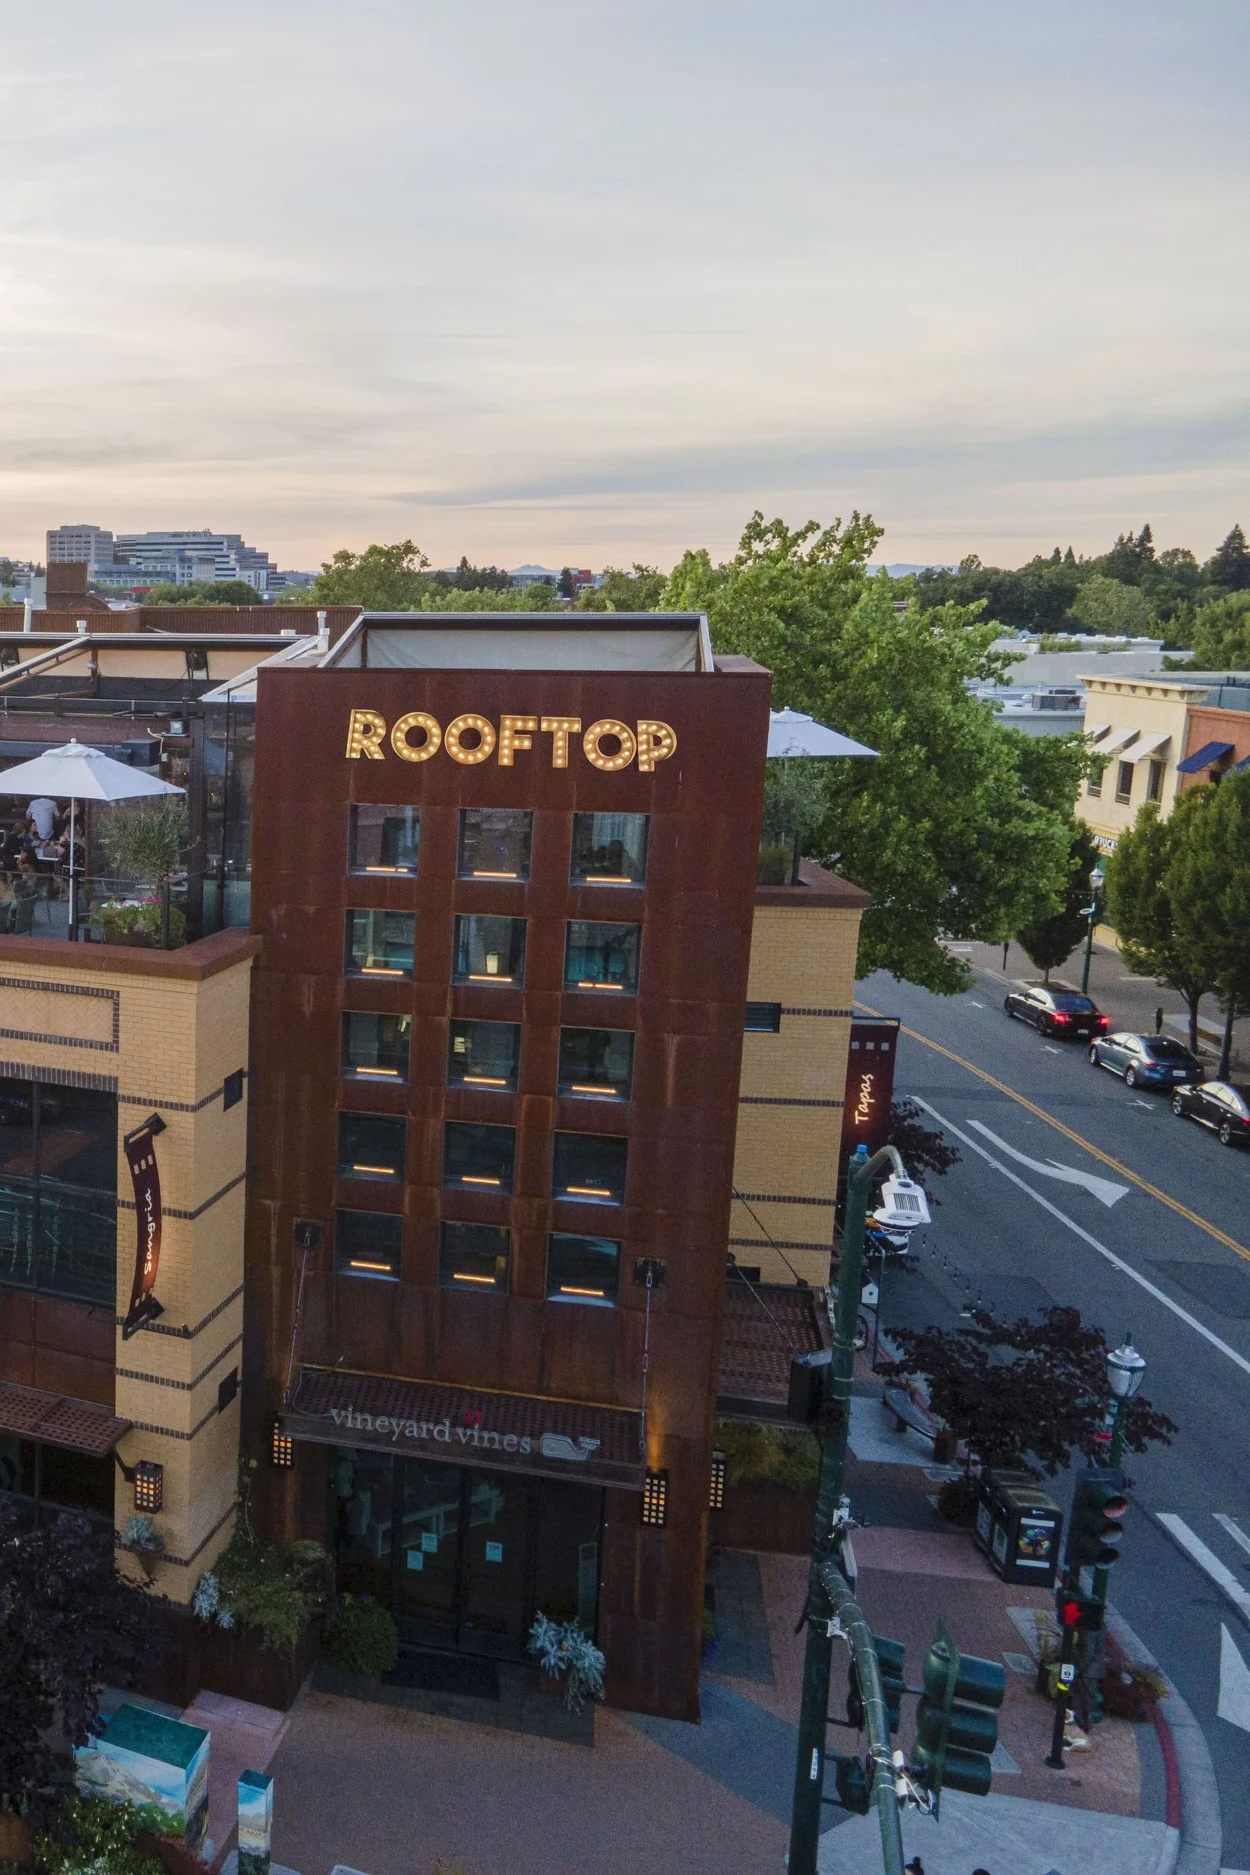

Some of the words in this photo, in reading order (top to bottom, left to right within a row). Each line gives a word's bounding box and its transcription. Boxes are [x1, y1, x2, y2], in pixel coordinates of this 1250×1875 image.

[345, 708, 677, 773] ROOFTOP
[854, 1073, 876, 1125] Tapas
[144, 1188, 156, 1275] Sangria
[330, 1404, 451, 1444] vineyard
[455, 1422, 532, 1455] vines
